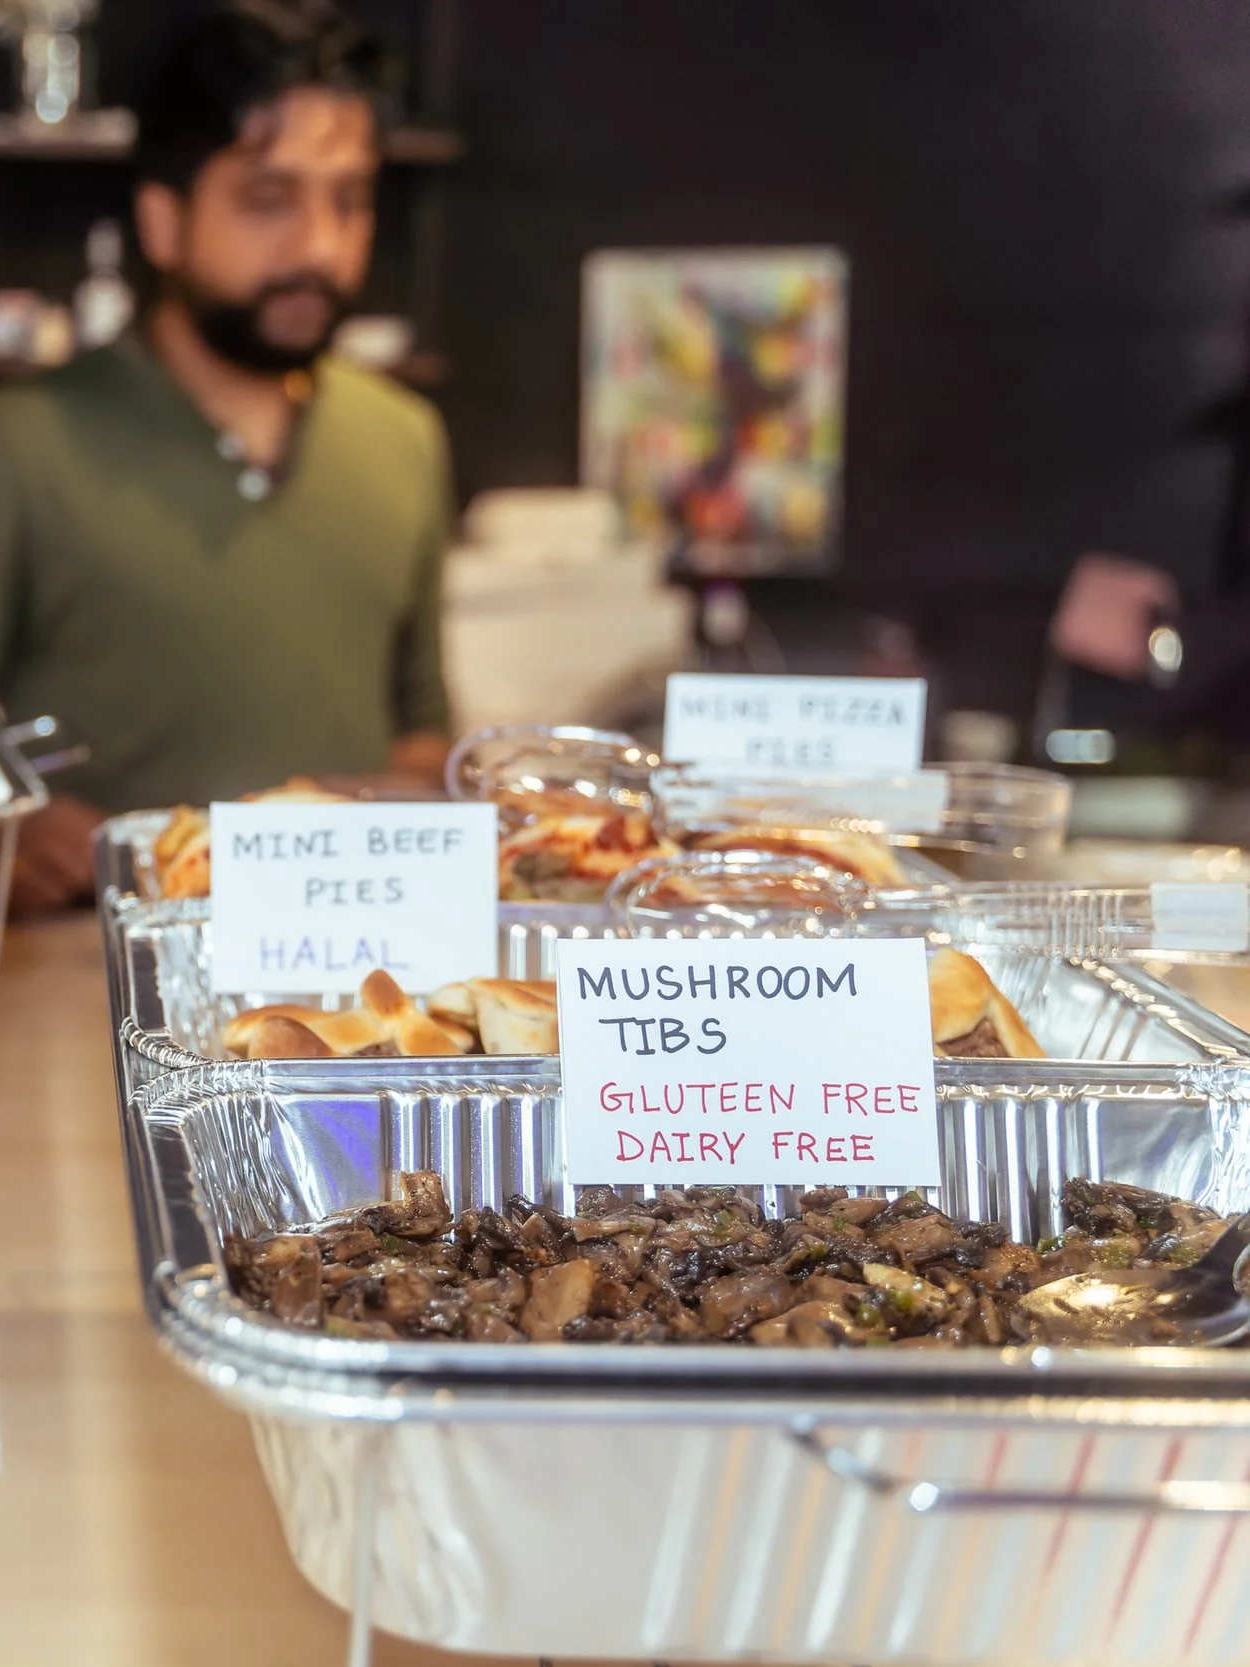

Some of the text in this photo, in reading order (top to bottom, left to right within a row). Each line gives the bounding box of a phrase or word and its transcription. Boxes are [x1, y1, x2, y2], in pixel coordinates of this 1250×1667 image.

[679, 694, 907, 727] MINI PIZZA
[745, 736, 835, 766] PIES
[232, 816, 464, 862] MINI BEEF
[304, 876, 405, 908] PIES
[258, 934, 410, 971] HALAL
[577, 963, 857, 1001] MUSHROOM
[598, 1017, 727, 1055] TIBS
[600, 1081, 921, 1116] GLUTEEN FREE
[616, 1130, 875, 1165] DAIRY FREE
